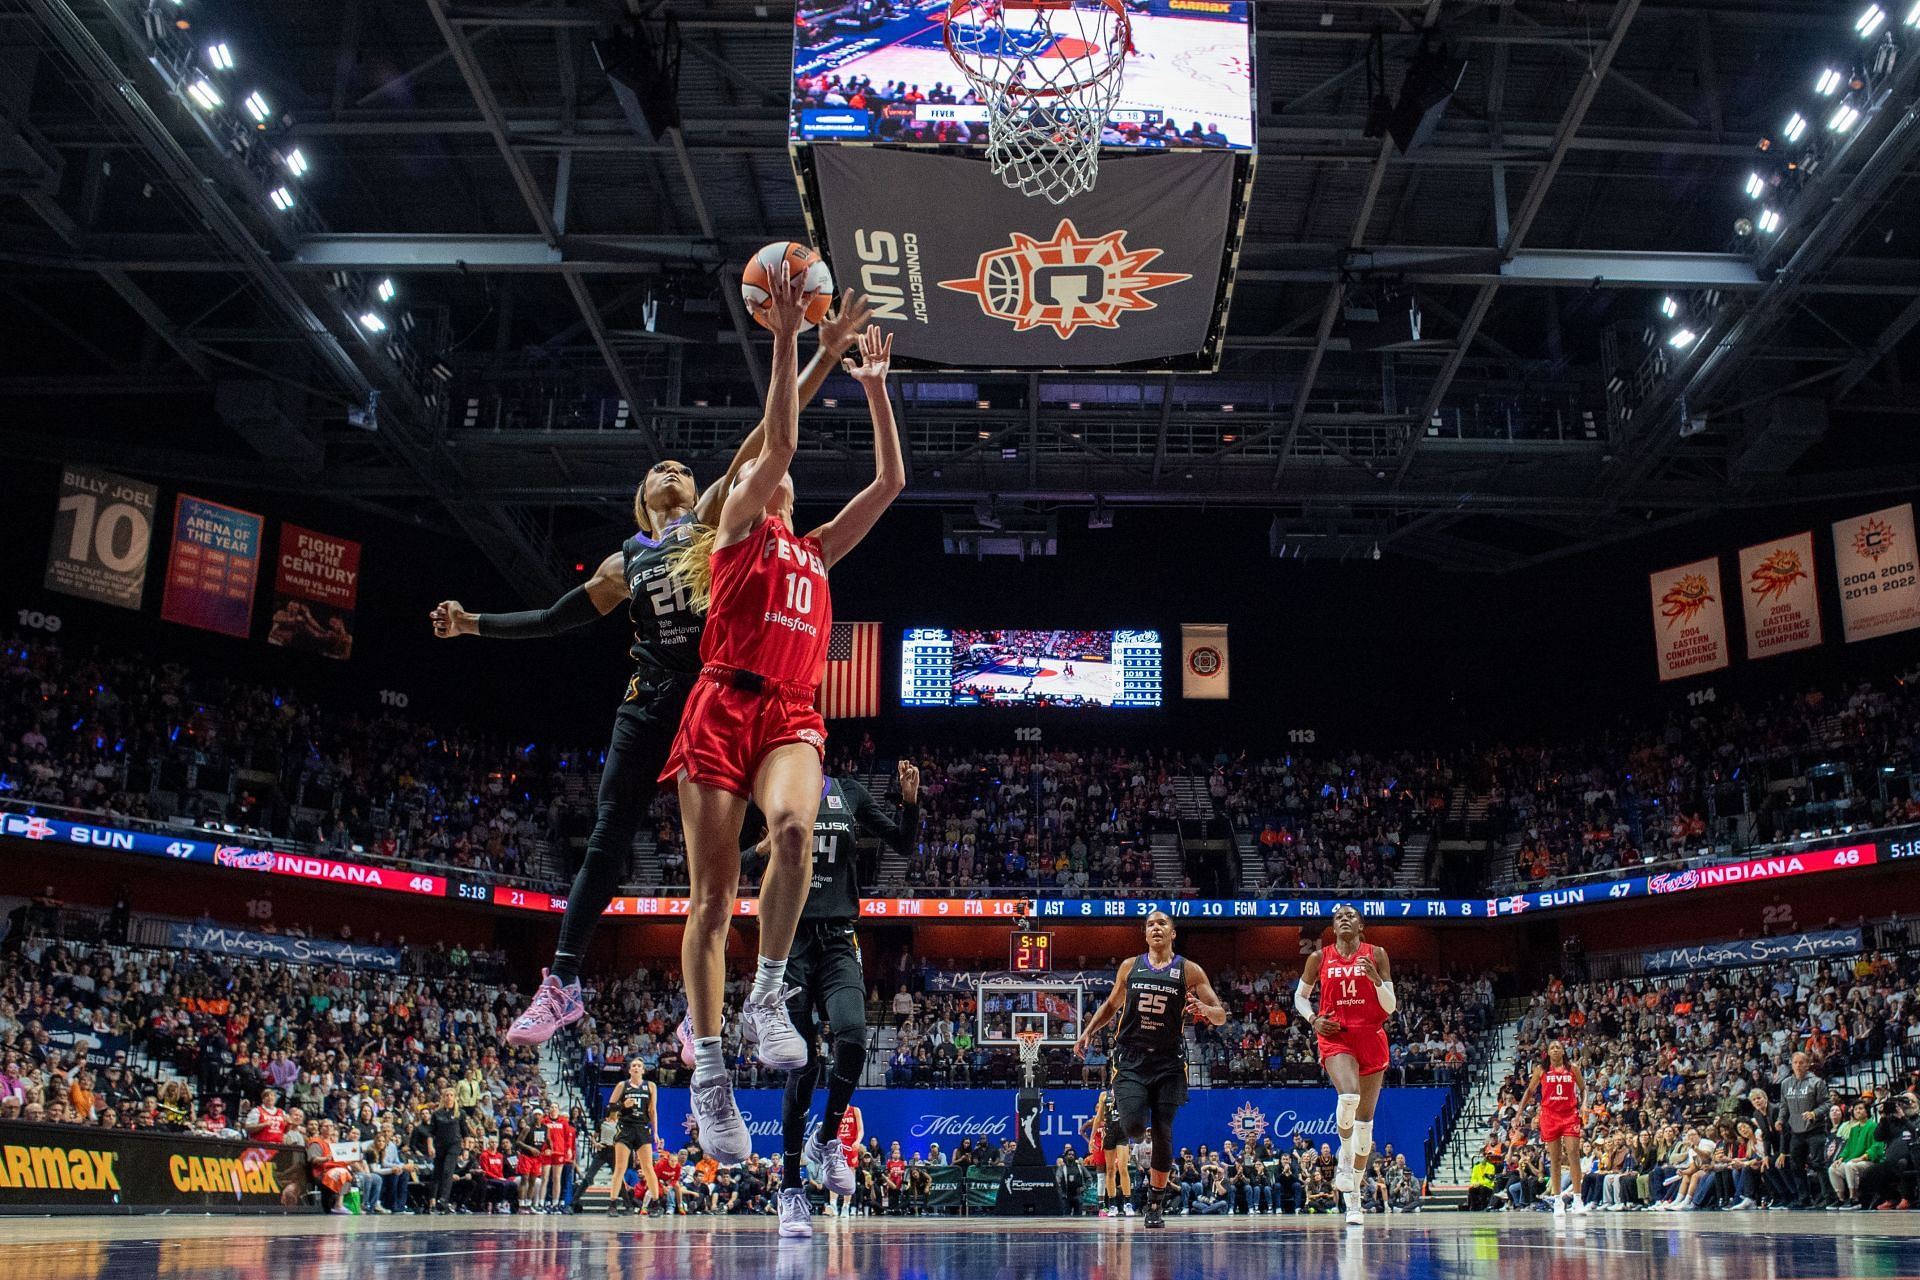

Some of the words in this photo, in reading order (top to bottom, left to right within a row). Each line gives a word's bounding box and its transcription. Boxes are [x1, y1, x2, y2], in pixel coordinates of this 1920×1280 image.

[855, 228, 908, 321] SUN
[903, 232, 929, 324] CONNECTICUT
[63, 471, 108, 495] BILLY
[112, 485, 152, 509] JOEL
[59, 493, 149, 572] 10
[186, 516, 231, 537] ARENA
[233, 529, 250, 541] OF
[187, 528, 212, 545] THE
[215, 535, 249, 553] YEAR
[298, 534, 346, 559] FIGHT
[301, 548, 316, 561] OF
[319, 553, 340, 568] THE
[282, 554, 356, 585] CENTURY
[1843, 571, 1876, 586] 2004
[1881, 561, 1914, 578] 2005
[646, 577, 687, 617] 21
[786, 572, 812, 614] 10
[1845, 584, 1878, 600] 2019
[1882, 576, 1916, 591] 2022
[1770, 603, 1792, 615] 2005
[17, 608, 62, 633] 109
[657, 620, 672, 628] Yale
[764, 611, 817, 637] salesforce
[1755, 619, 1811, 639] CONFERENCE
[1763, 611, 1801, 628] EASTERN
[660, 635, 688, 646] Health
[1673, 634, 1709, 649] EASTERN
[1680, 627, 1700, 639] 2004
[1758, 630, 1810, 649] CHAMPIONS
[1666, 641, 1718, 661] CONFERENCE
[1669, 652, 1717, 670] CHAMPIONS
[379, 688, 409, 708] 110
[1686, 687, 1717, 707] 114
[1014, 727, 1042, 742] 112
[1287, 729, 1317, 744] 113
[70, 826, 135, 850] SUN
[166, 841, 195, 858] 47
[1650, 869, 1700, 894] Fever
[1701, 857, 1805, 885] INDIANA
[1833, 849, 1860, 866] 46
[277, 854, 382, 886] INDIANA
[409, 876, 433, 893] 46
[458, 883, 486, 900] 5:18
[510, 891, 525, 906] 21
[550, 898, 568, 910] 3RD
[1539, 888, 1585, 907] SUN
[1609, 882, 1631, 898] 47
[636, 900, 657, 913] REB
[865, 902, 887, 914] 48
[898, 900, 920, 915] FTM
[938, 902, 949, 914] 9
[964, 900, 983, 915] FTA
[993, 902, 1013, 914] 10
[1044, 900, 1065, 915] AST
[1080, 902, 1092, 915] 8
[1104, 901, 1125, 915] REB
[1170, 901, 1190, 916] T/O
[1202, 903, 1222, 915] 10
[1234, 901, 1257, 916] FGM
[1269, 903, 1289, 915] 17
[1300, 901, 1320, 916] FGA
[1363, 901, 1385, 916] FTM
[1401, 903, 1411, 915] 7
[1428, 901, 1446, 916] FTA
[1461, 903, 1472, 915] 8
[1762, 904, 1793, 924] 22
[202, 928, 289, 958] Mohegan
[291, 940, 332, 960] Sun
[335, 944, 396, 967] Arena
[1021, 935, 1047, 948] 5:18
[1669, 945, 1748, 968] Mohegan
[1750, 941, 1789, 961] Sun
[1791, 934, 1857, 955] Arena
[1018, 949, 1044, 969] 21
[952, 971, 1023, 991] Mohegan
[1327, 965, 1366, 979] FEVE
[1131, 982, 1179, 996] KEESUSK
[1340, 979, 1358, 998] 14
[1138, 992, 1168, 1015] 25
[1336, 998, 1366, 1007] salesforce
[1546, 1076, 1573, 1084] FEVER
[1556, 1084, 1563, 1096] 0
[840, 1124, 850, 1133] 22
[910, 1114, 1011, 1138] Michelob
[970, 1182, 988, 1191] LUX
